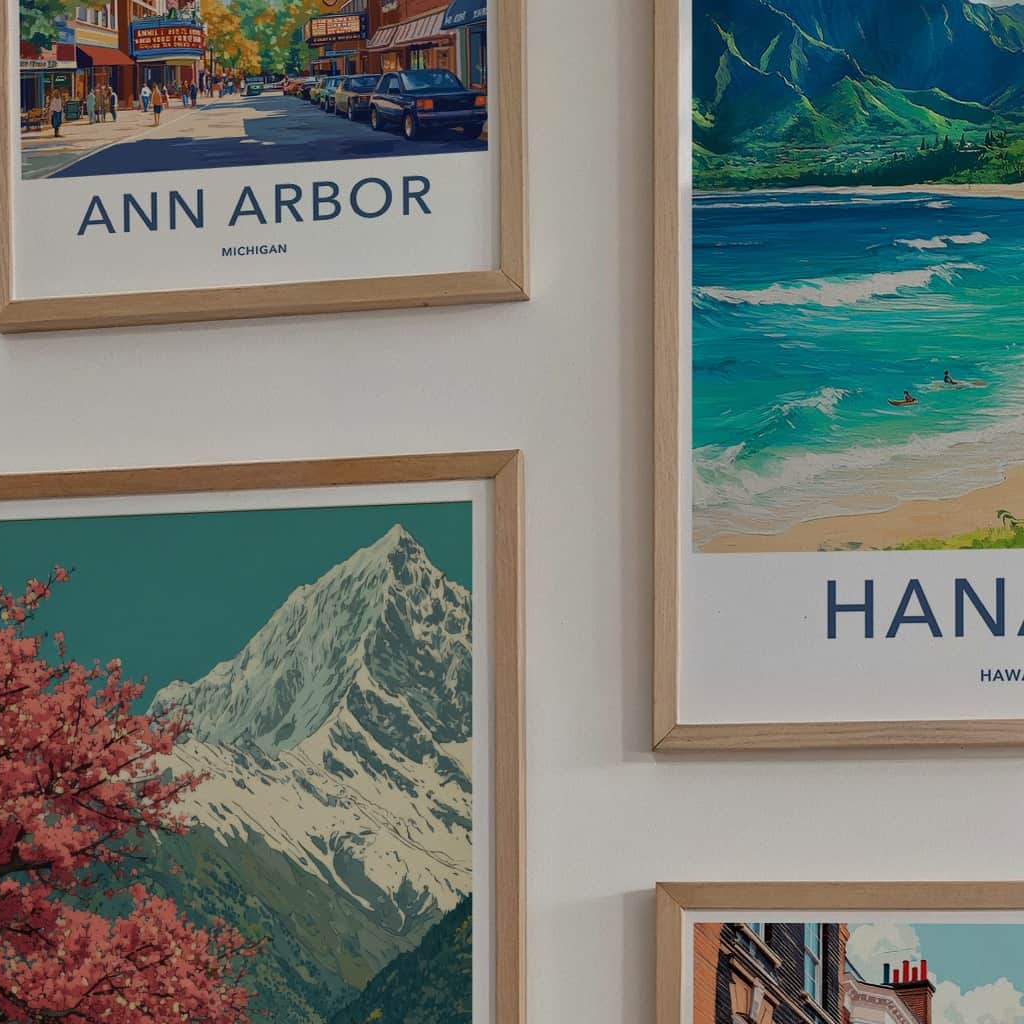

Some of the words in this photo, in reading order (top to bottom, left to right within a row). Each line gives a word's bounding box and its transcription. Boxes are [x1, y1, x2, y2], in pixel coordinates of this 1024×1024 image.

[77, 189, 205, 236] ANN
[228, 175, 432, 227] ARBOR
[221, 244, 287, 257] MICHIGAN
[826, 577, 1024, 639] HAN
[980, 668, 1024, 682] HAW
